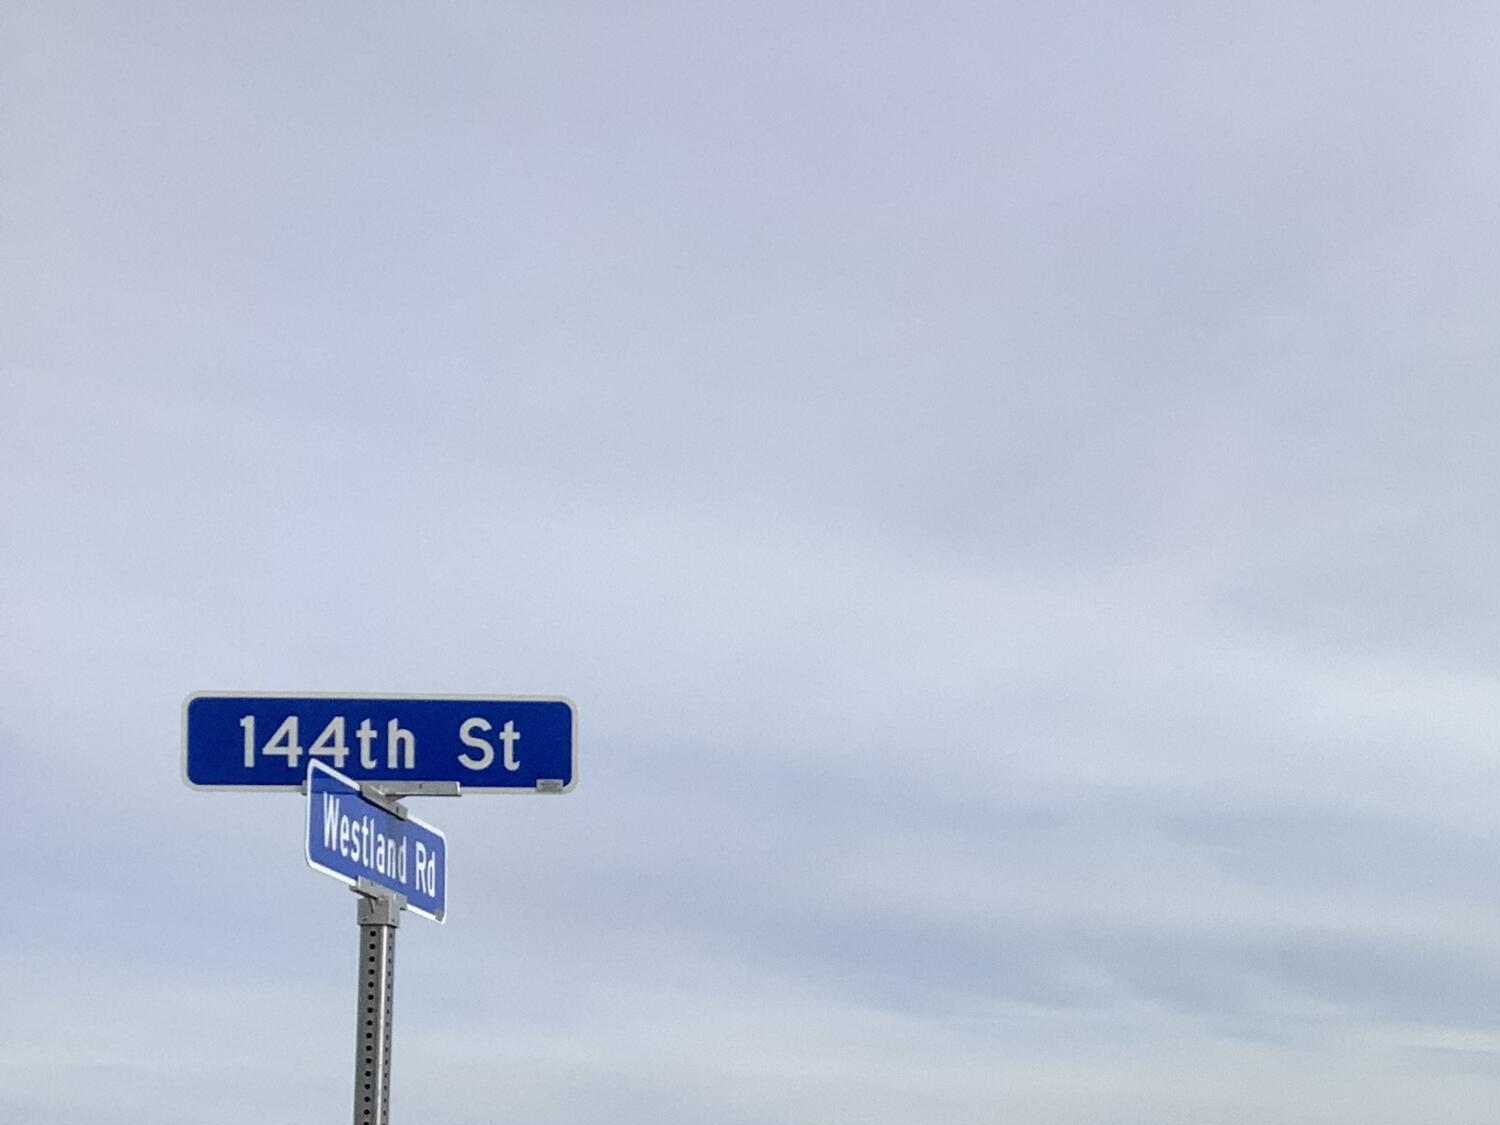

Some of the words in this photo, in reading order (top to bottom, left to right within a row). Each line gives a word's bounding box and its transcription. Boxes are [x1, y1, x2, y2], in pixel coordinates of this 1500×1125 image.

[239, 715, 416, 769] 144th
[457, 717, 521, 771] St
[323, 791, 408, 884] Westland
[415, 841, 436, 898] Rd
